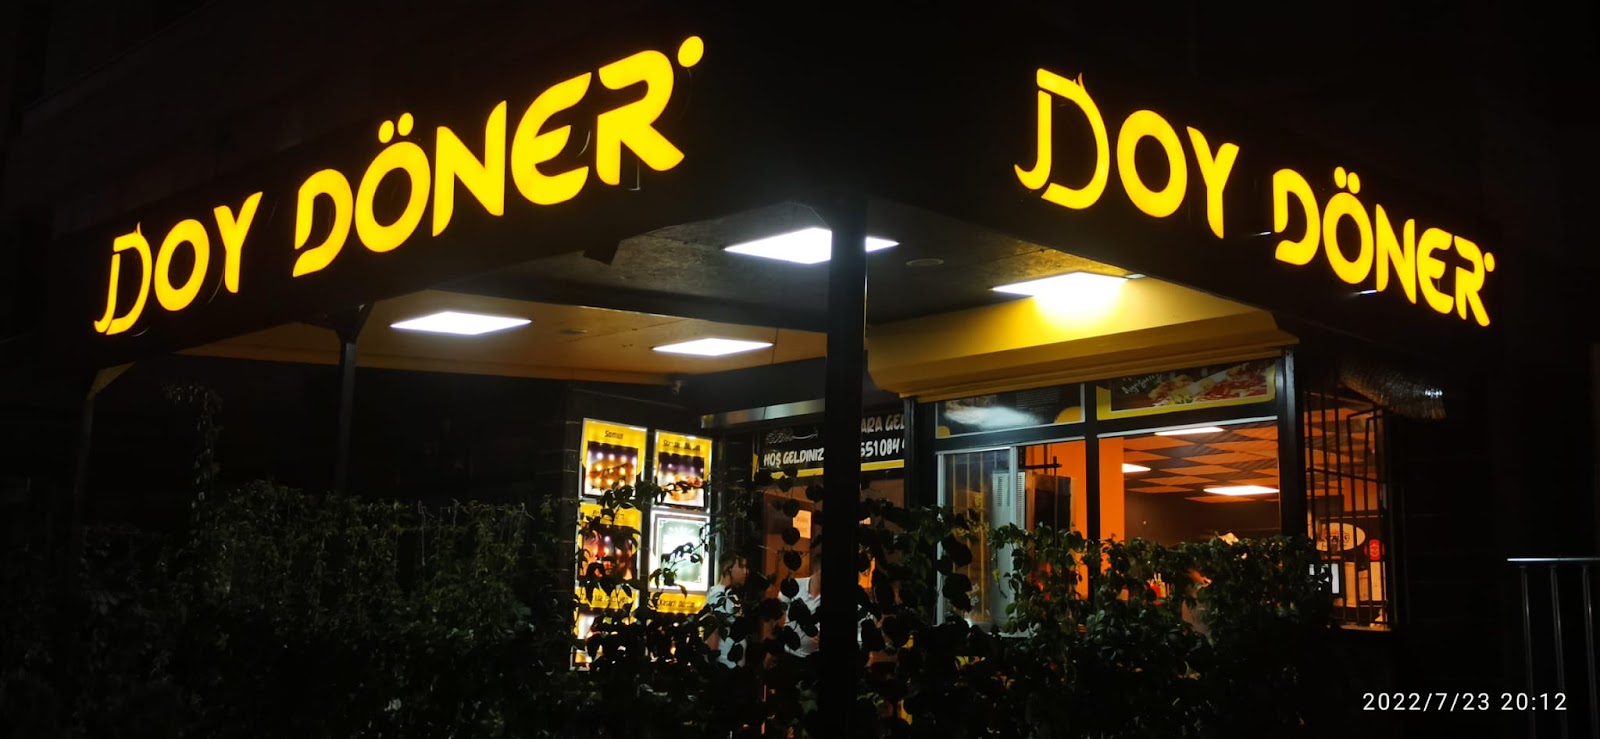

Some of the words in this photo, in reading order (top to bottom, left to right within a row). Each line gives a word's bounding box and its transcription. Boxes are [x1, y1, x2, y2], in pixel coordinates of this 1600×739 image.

[94, 191, 263, 336] DOY
[293, 36, 705, 278] DÖNER
[1014, 68, 1239, 239] DOY
[1272, 166, 1496, 327] DÖNER
[763, 451, 781, 468] HOŞ
